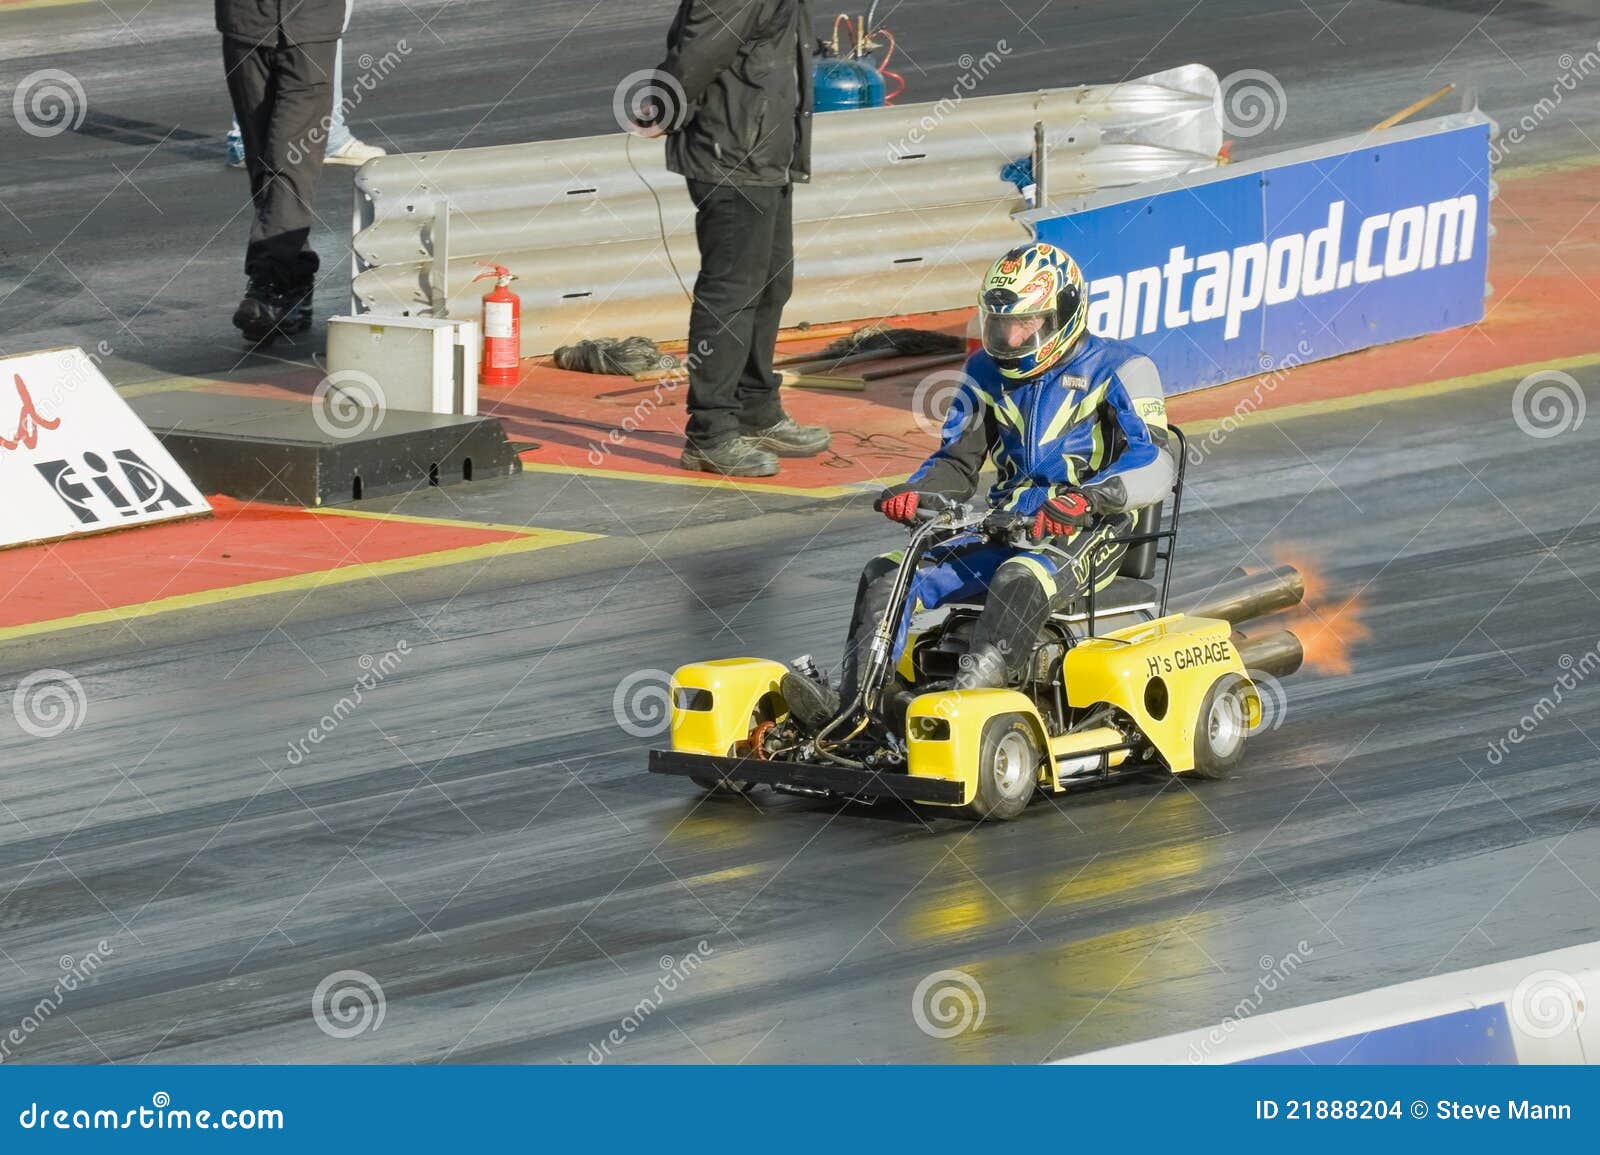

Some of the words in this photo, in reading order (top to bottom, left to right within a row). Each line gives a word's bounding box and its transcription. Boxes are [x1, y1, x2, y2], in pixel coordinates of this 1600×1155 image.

[990, 276, 1017, 287] agv
[1085, 194, 1478, 341] antapod.com
[1174, 641, 1231, 670] GARAGE
